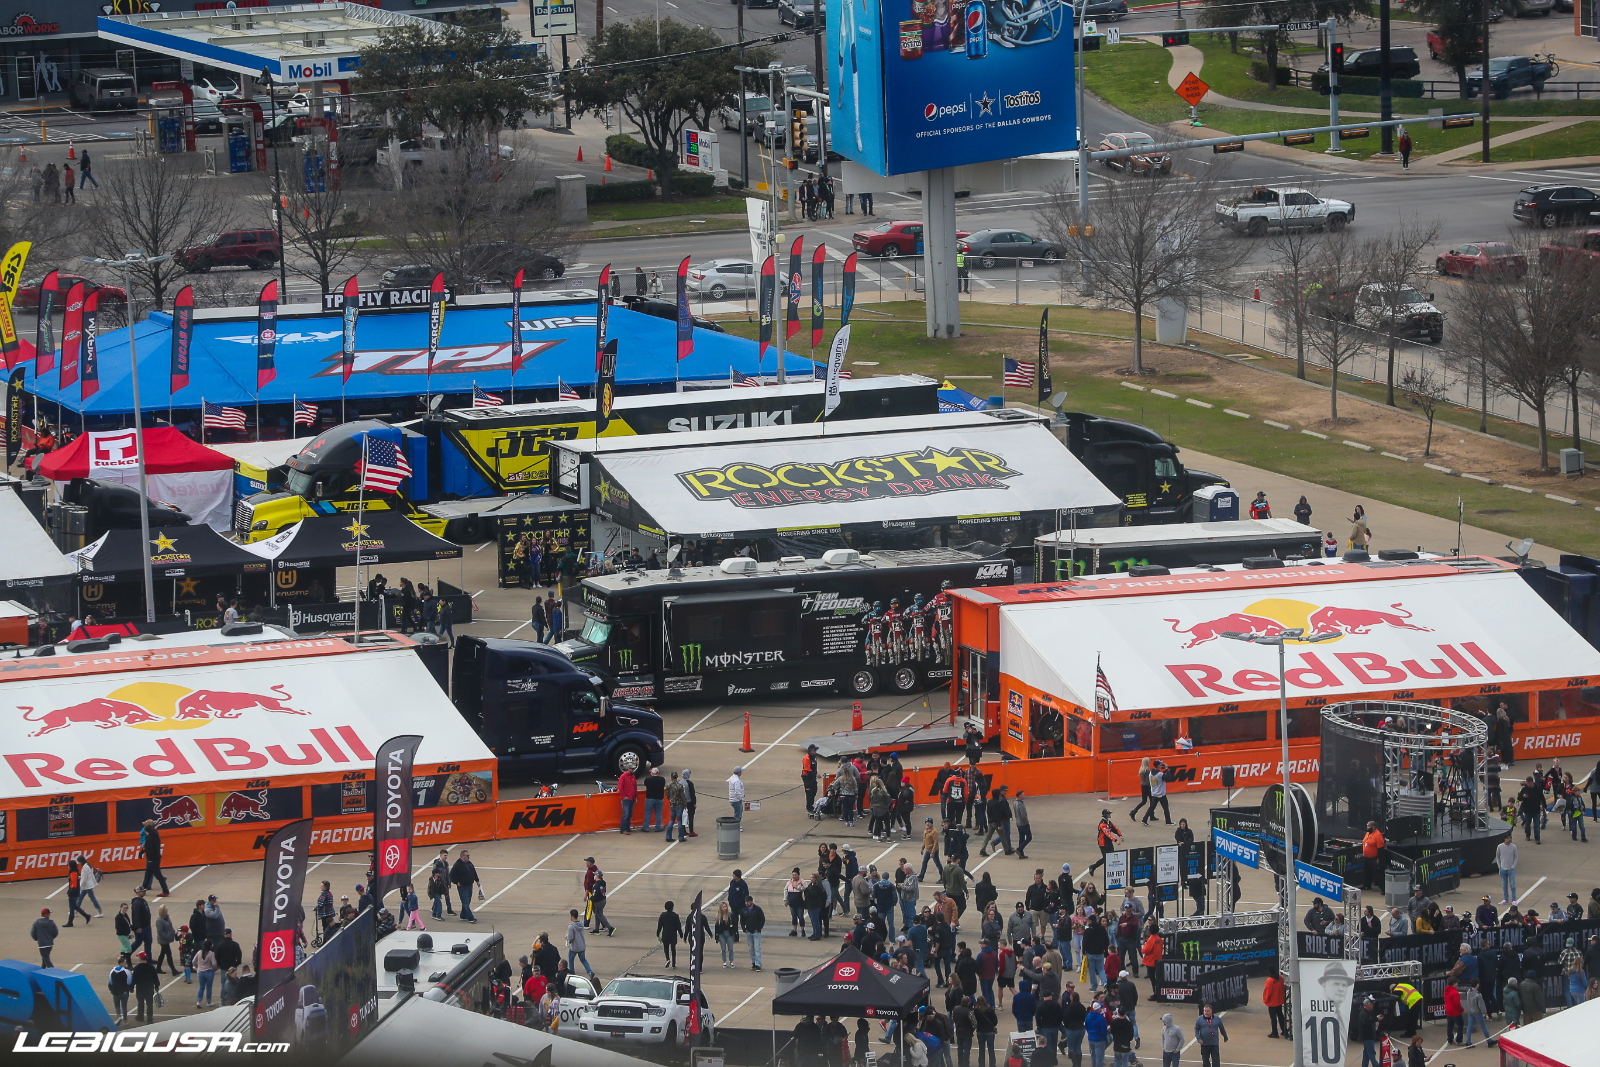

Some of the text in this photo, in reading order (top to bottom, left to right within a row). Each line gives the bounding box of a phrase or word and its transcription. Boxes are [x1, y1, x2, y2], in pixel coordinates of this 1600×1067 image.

[1286, 22, 1312, 31] COLLINS
[288, 62, 332, 80] Mobil
[939, 101, 967, 118] pepsi
[915, 114, 1052, 138] OFFICIAL SPONSORS OF THE DALLAS COWBOYS
[324, 288, 450, 308] TP FLY RACIG
[178, 310, 189, 371] LUCAS OIL
[667, 409, 793, 433] SUZUKI
[686, 448, 1010, 497] ROCKSTAR
[731, 472, 1003, 506] ENERGY DRINK
[977, 564, 1009, 576] KTM
[817, 592, 839, 601] TEAM
[813, 597, 864, 611] TEDDER
[302, 611, 356, 625] Husqvarna
[74, 650, 210, 667] FACTORY
[705, 650, 785, 668] MONSTER
[1480, 684, 1501, 693] KTM
[1567, 677, 1588, 687] KTM
[1305, 696, 1327, 706] KTM
[1393, 690, 1414, 700] KTM
[1130, 710, 1152, 719] KTM
[1217, 704, 1239, 713] KTM
[572, 722, 599, 733] KTM
[437, 763, 461, 774] KTM
[1166, 762, 1272, 783] TM FATORY
[342, 771, 366, 781] KTM
[246, 778, 270, 789] KTM
[386, 748, 405, 832] TOYOTA
[413, 779, 435, 789] WEBB
[149, 787, 173, 797] KTM
[417, 789, 427, 806] 1
[951, 787, 963, 798] 51
[50, 795, 74, 805] KTM
[508, 803, 577, 831] KTM
[1237, 820, 1260, 828] MONSTE
[310, 826, 374, 845] FACTOR
[1215, 835, 1257, 862] FANFEST
[273, 835, 297, 924] TOYOTA
[1298, 867, 1341, 896] FANFEST
[1216, 937, 1258, 948] MONSTER
[1499, 927, 1524, 946] FAME
[1305, 934, 1341, 955] RIDE OF
[1202, 949, 1276, 961] SUPERCROSS
[1422, 942, 1448, 964] FAME
[1163, 962, 1188, 982] RIDE
[1160, 987, 1193, 996] DISCOUNT
[1431, 978, 1446, 999] RID
[265, 995, 285, 1022] TOYOTA
[876, 1008, 898, 1016] TOYOTA
[1310, 999, 1335, 1012] BLUE
[1427, 1005, 1446, 1013] DISCO
[1305, 1015, 1341, 1064] 10
